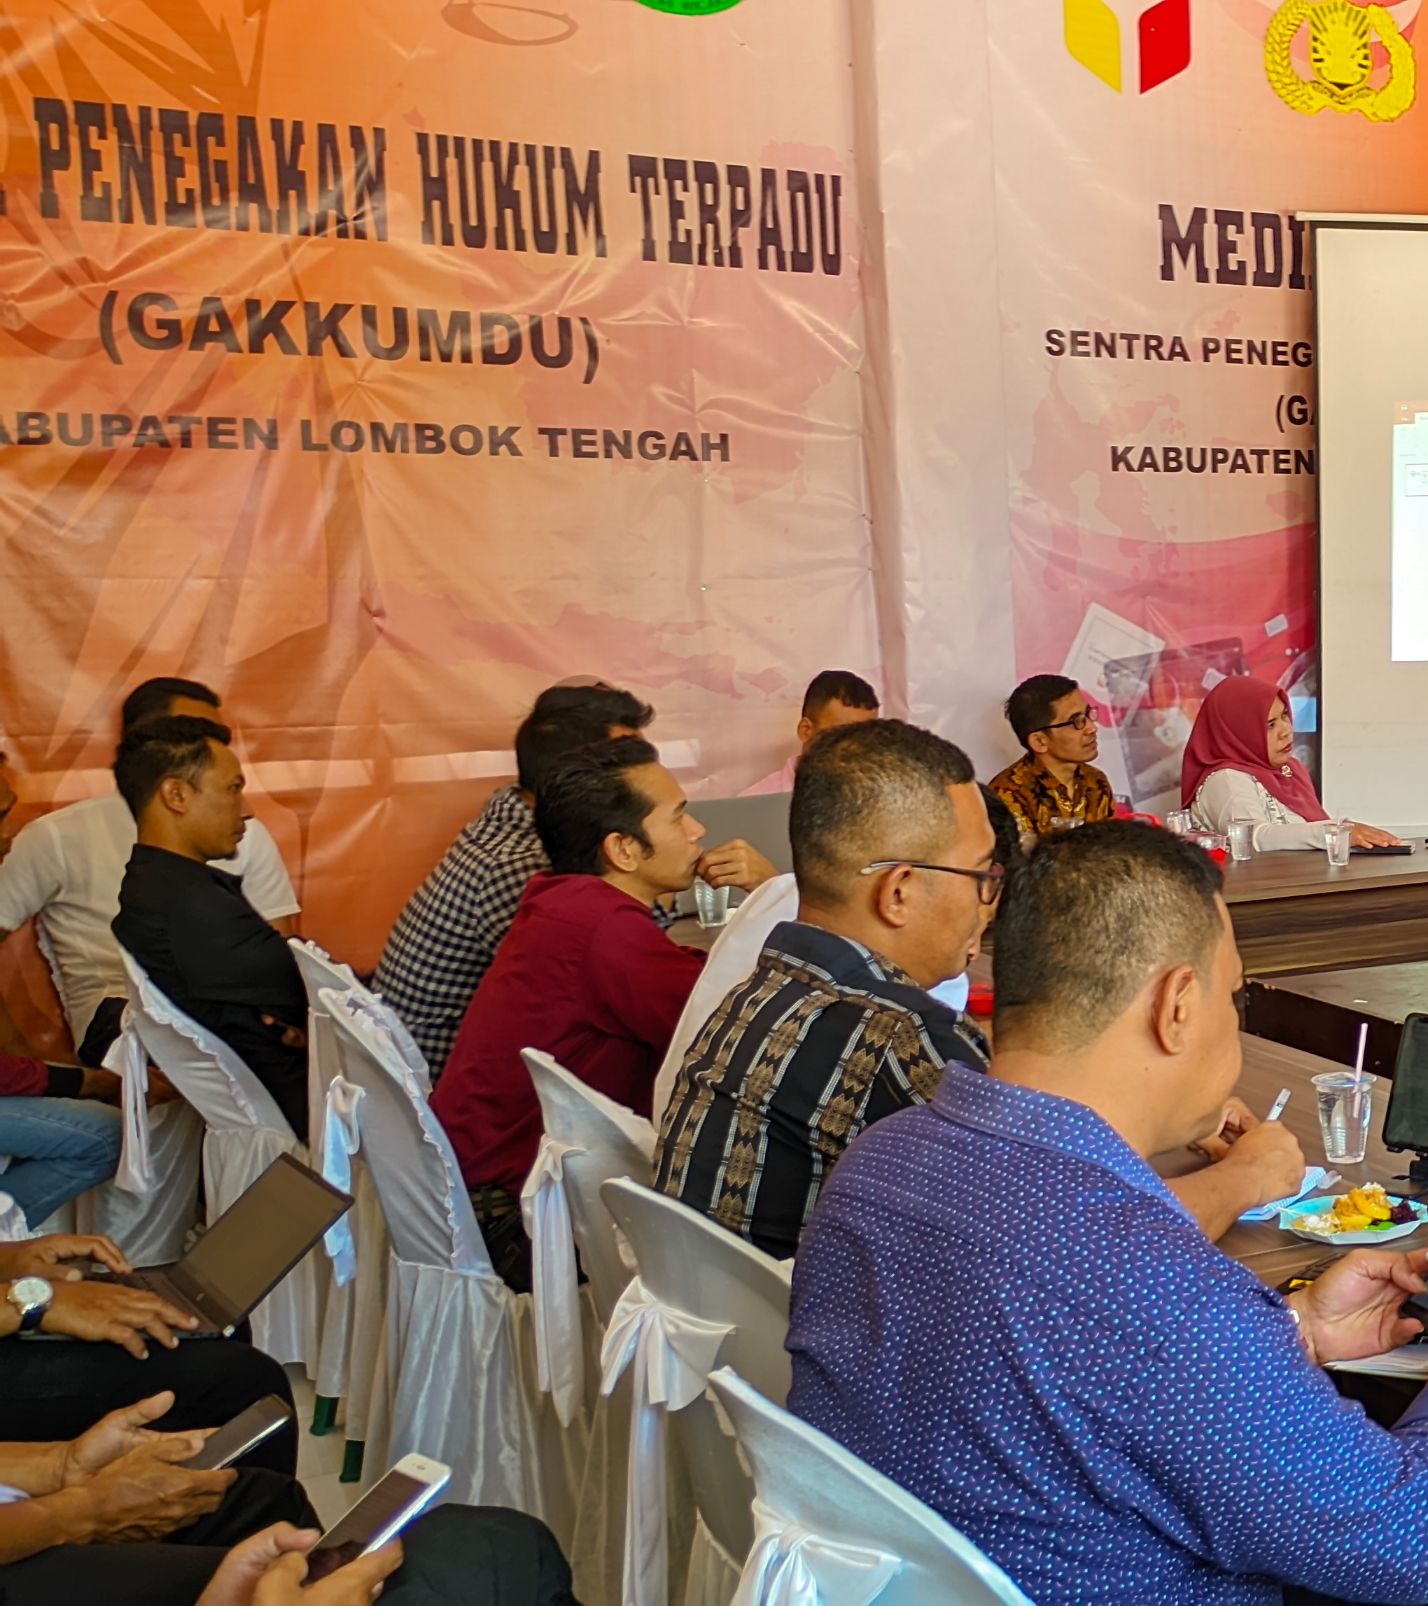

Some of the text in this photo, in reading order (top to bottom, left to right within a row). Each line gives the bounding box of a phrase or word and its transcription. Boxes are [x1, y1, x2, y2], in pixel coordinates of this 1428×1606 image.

[33, 97, 842, 276] PENEGAKAN HUKUM TERPADU
[1158, 203, 1312, 290] MEDI
[99, 290, 600, 385] (GAKKUMDU)
[1045, 329, 1191, 362] SENTRA
[301, 418, 524, 457] LOMBOK
[538, 427, 730, 462] TENGAH
[1110, 446, 1315, 475] KABUPATEN
